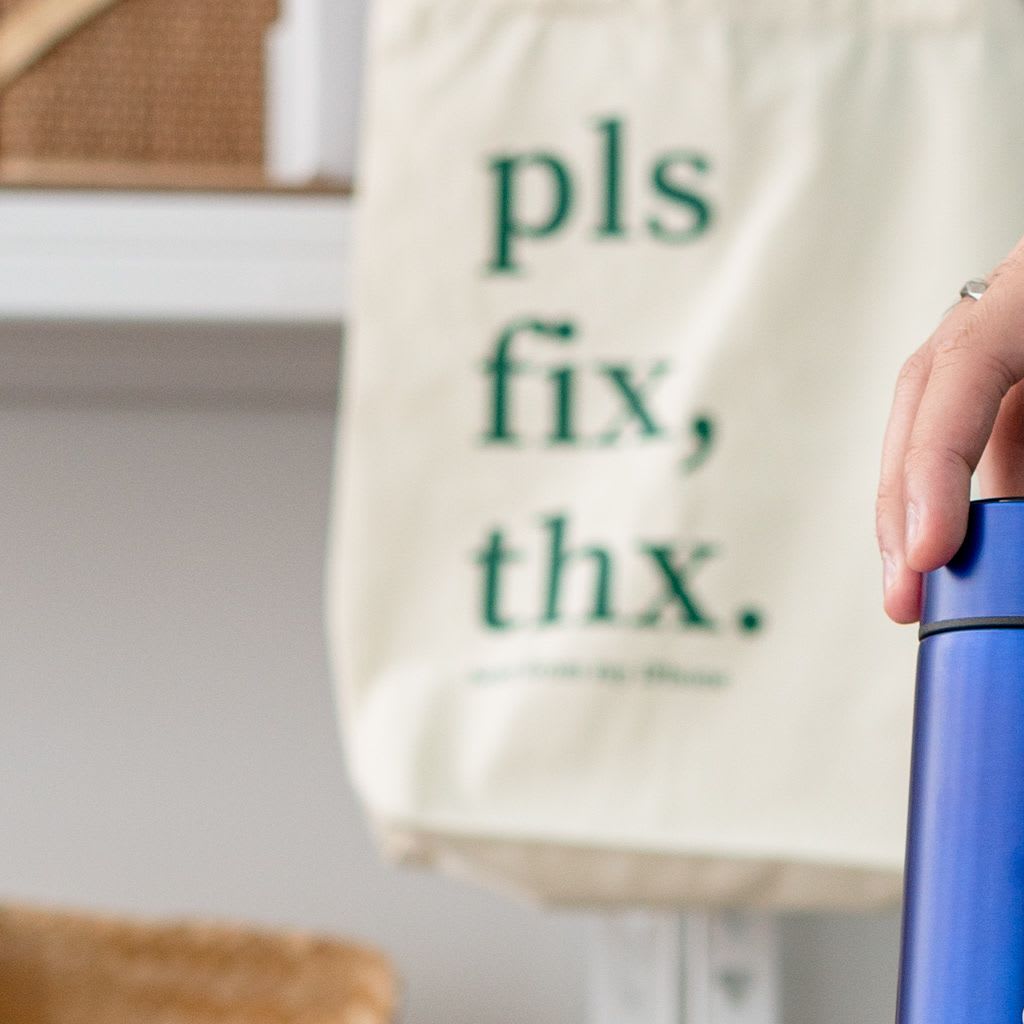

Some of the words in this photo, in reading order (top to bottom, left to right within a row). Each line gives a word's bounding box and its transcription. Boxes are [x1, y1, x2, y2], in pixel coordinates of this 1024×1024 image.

[483, 115, 716, 276] pls
[480, 317, 717, 470] fix,
[472, 512, 765, 634] thx.
